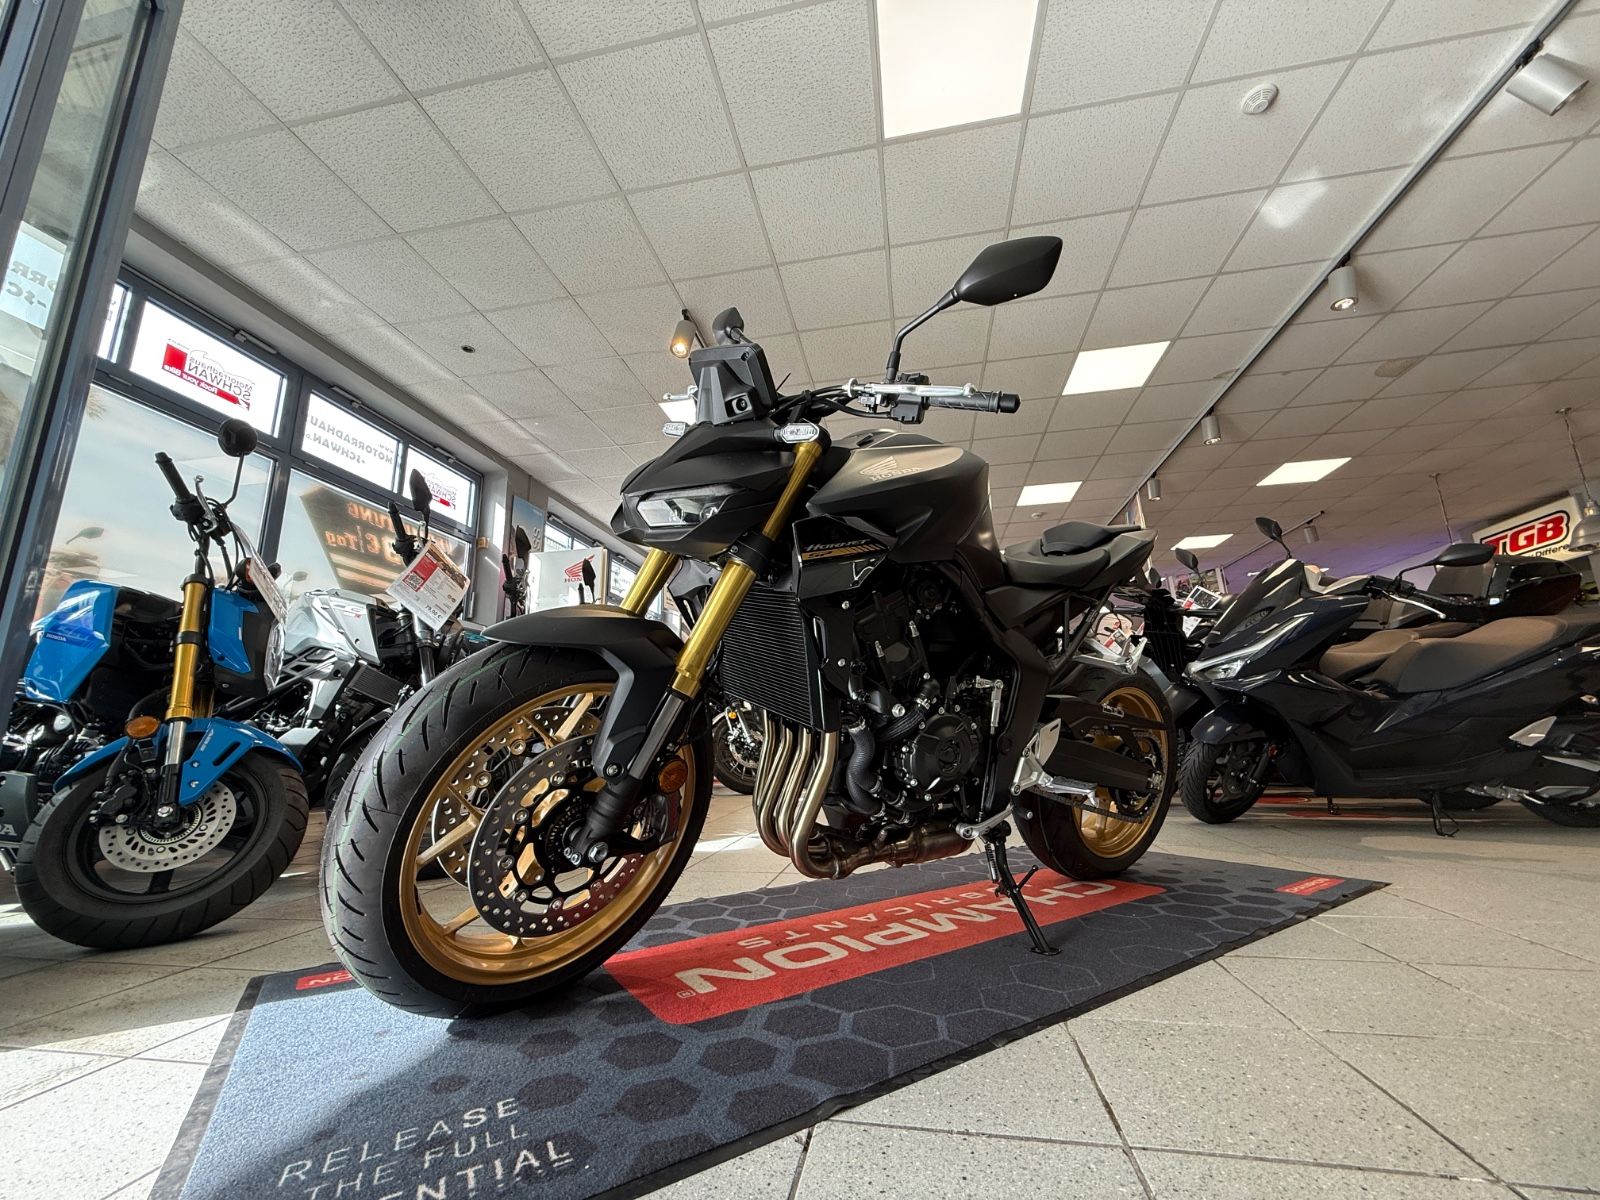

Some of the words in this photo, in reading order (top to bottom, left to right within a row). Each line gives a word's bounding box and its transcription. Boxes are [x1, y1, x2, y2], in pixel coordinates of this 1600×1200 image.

[869, 467, 923, 481] HONDA
[1485, 514, 1565, 555] TGB
[675, 881, 1117, 994] CHAMPION
[737, 884, 1032, 949] BRICANTS
[278, 1098, 519, 1188] RELEASE
[304, 1161, 400, 1200] THE
[423, 1124, 528, 1169] FULL
[380, 1141, 574, 1200] NTIAL
